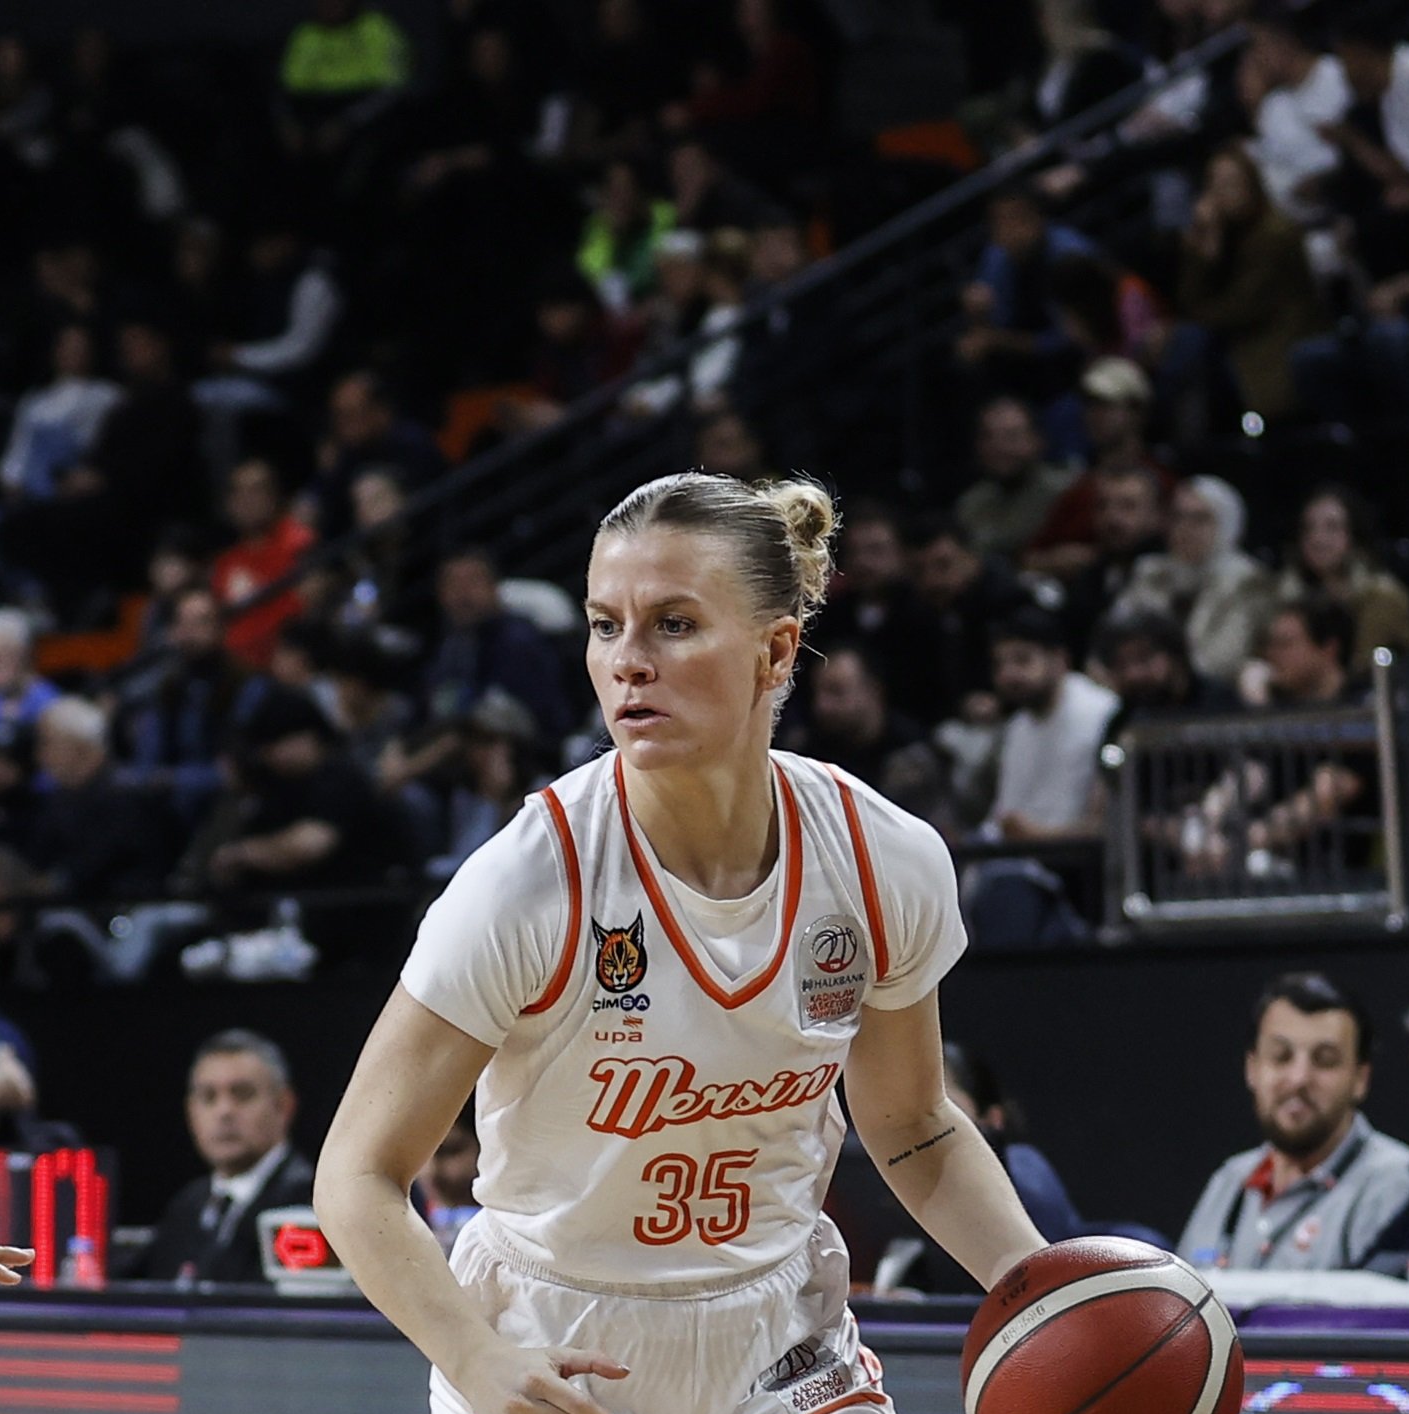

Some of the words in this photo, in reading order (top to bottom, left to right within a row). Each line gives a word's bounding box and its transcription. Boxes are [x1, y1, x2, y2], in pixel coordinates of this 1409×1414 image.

[594, 1030, 643, 1044] upa
[586, 1055, 839, 1139] Mersin
[633, 1148, 759, 1246] 35
